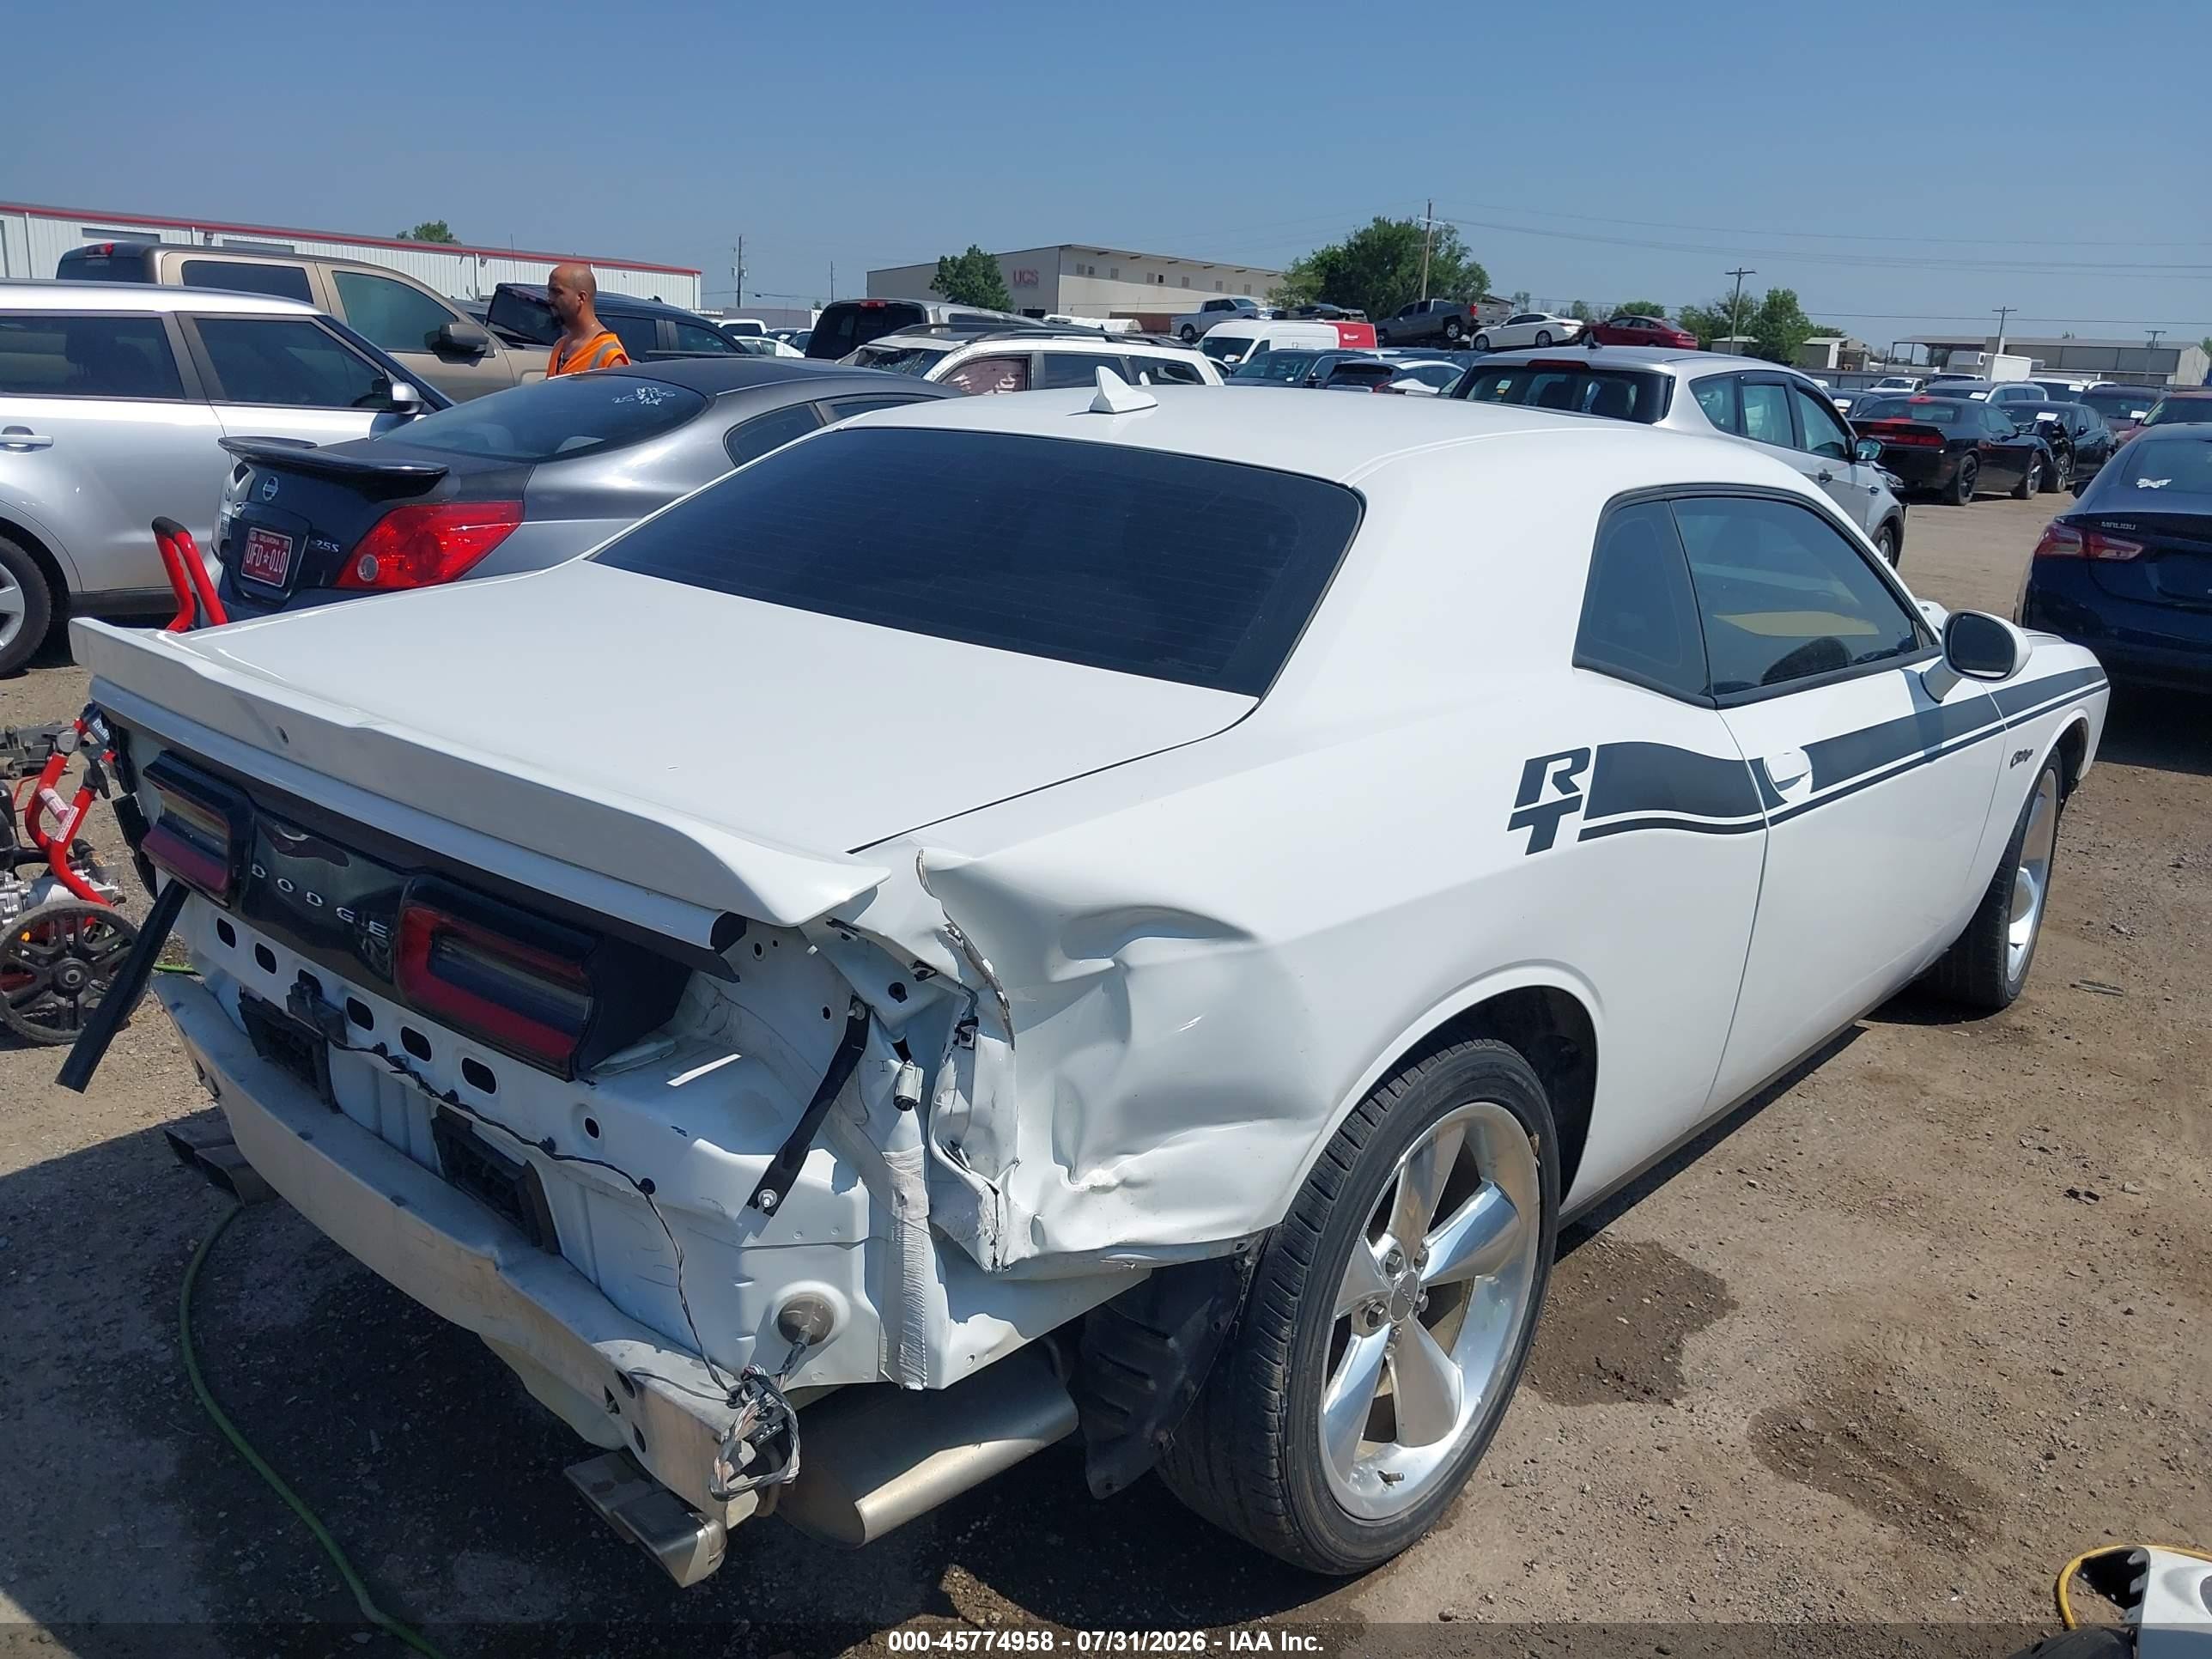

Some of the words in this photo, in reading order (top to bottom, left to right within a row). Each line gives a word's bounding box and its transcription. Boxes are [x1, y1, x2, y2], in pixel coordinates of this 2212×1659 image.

[1514, 746, 1591, 809] R
[1506, 793, 1583, 856] T
[252, 863, 387, 939] DODGE
